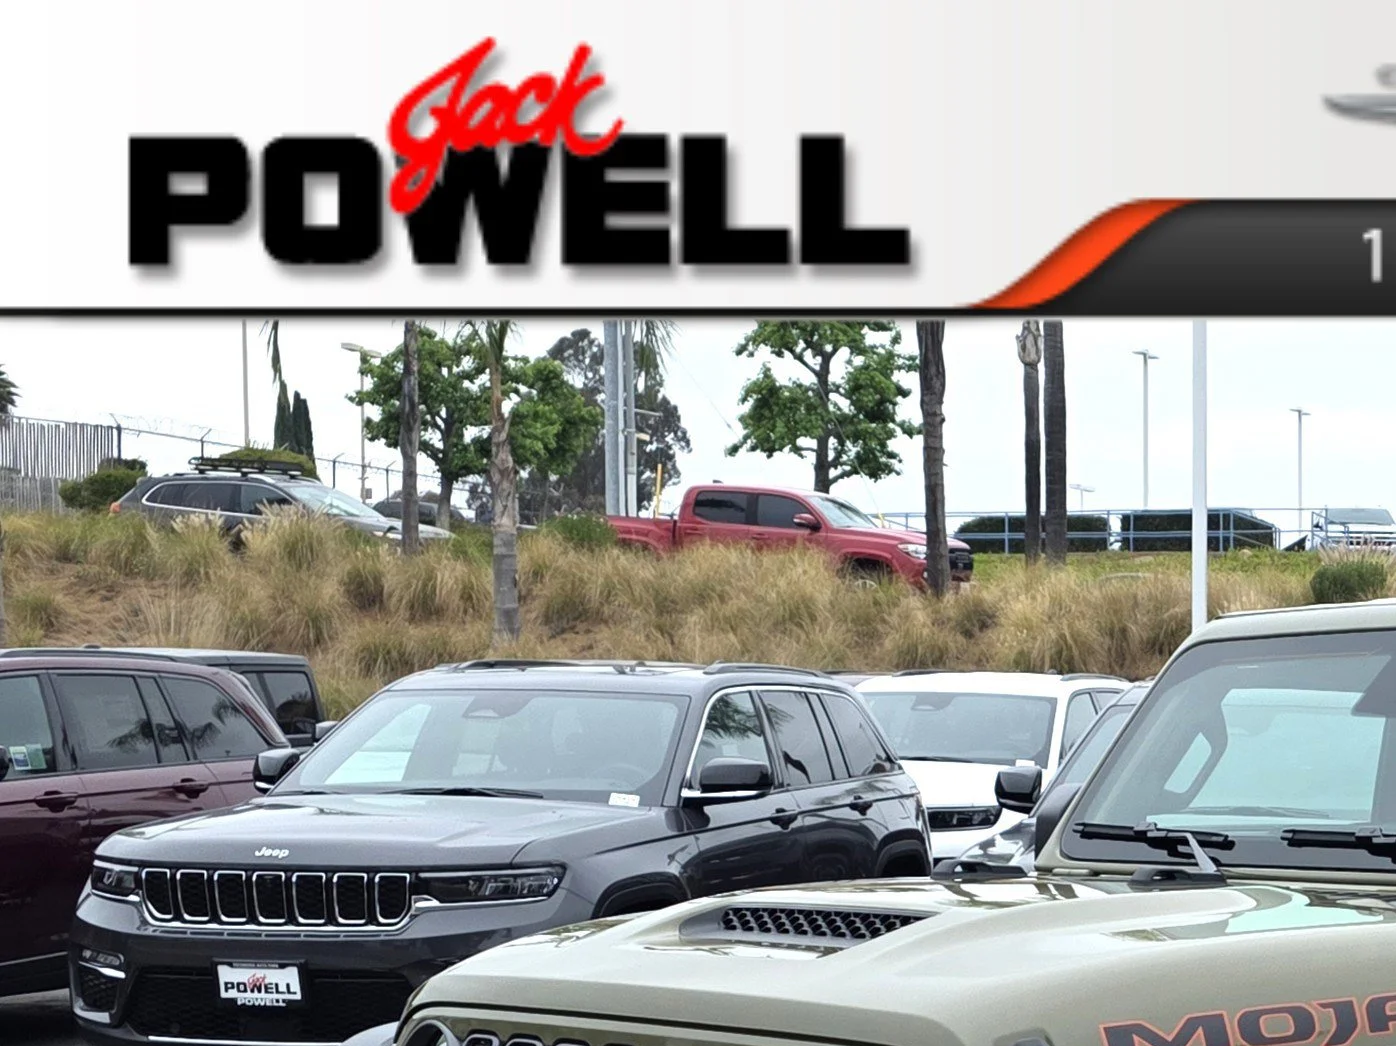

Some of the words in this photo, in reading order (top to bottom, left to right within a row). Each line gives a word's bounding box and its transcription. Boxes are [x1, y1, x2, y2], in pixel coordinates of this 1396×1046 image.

[254, 846, 290, 859] Jeep
[224, 981, 297, 995] POWELL
[237, 998, 287, 1007] POWELL
